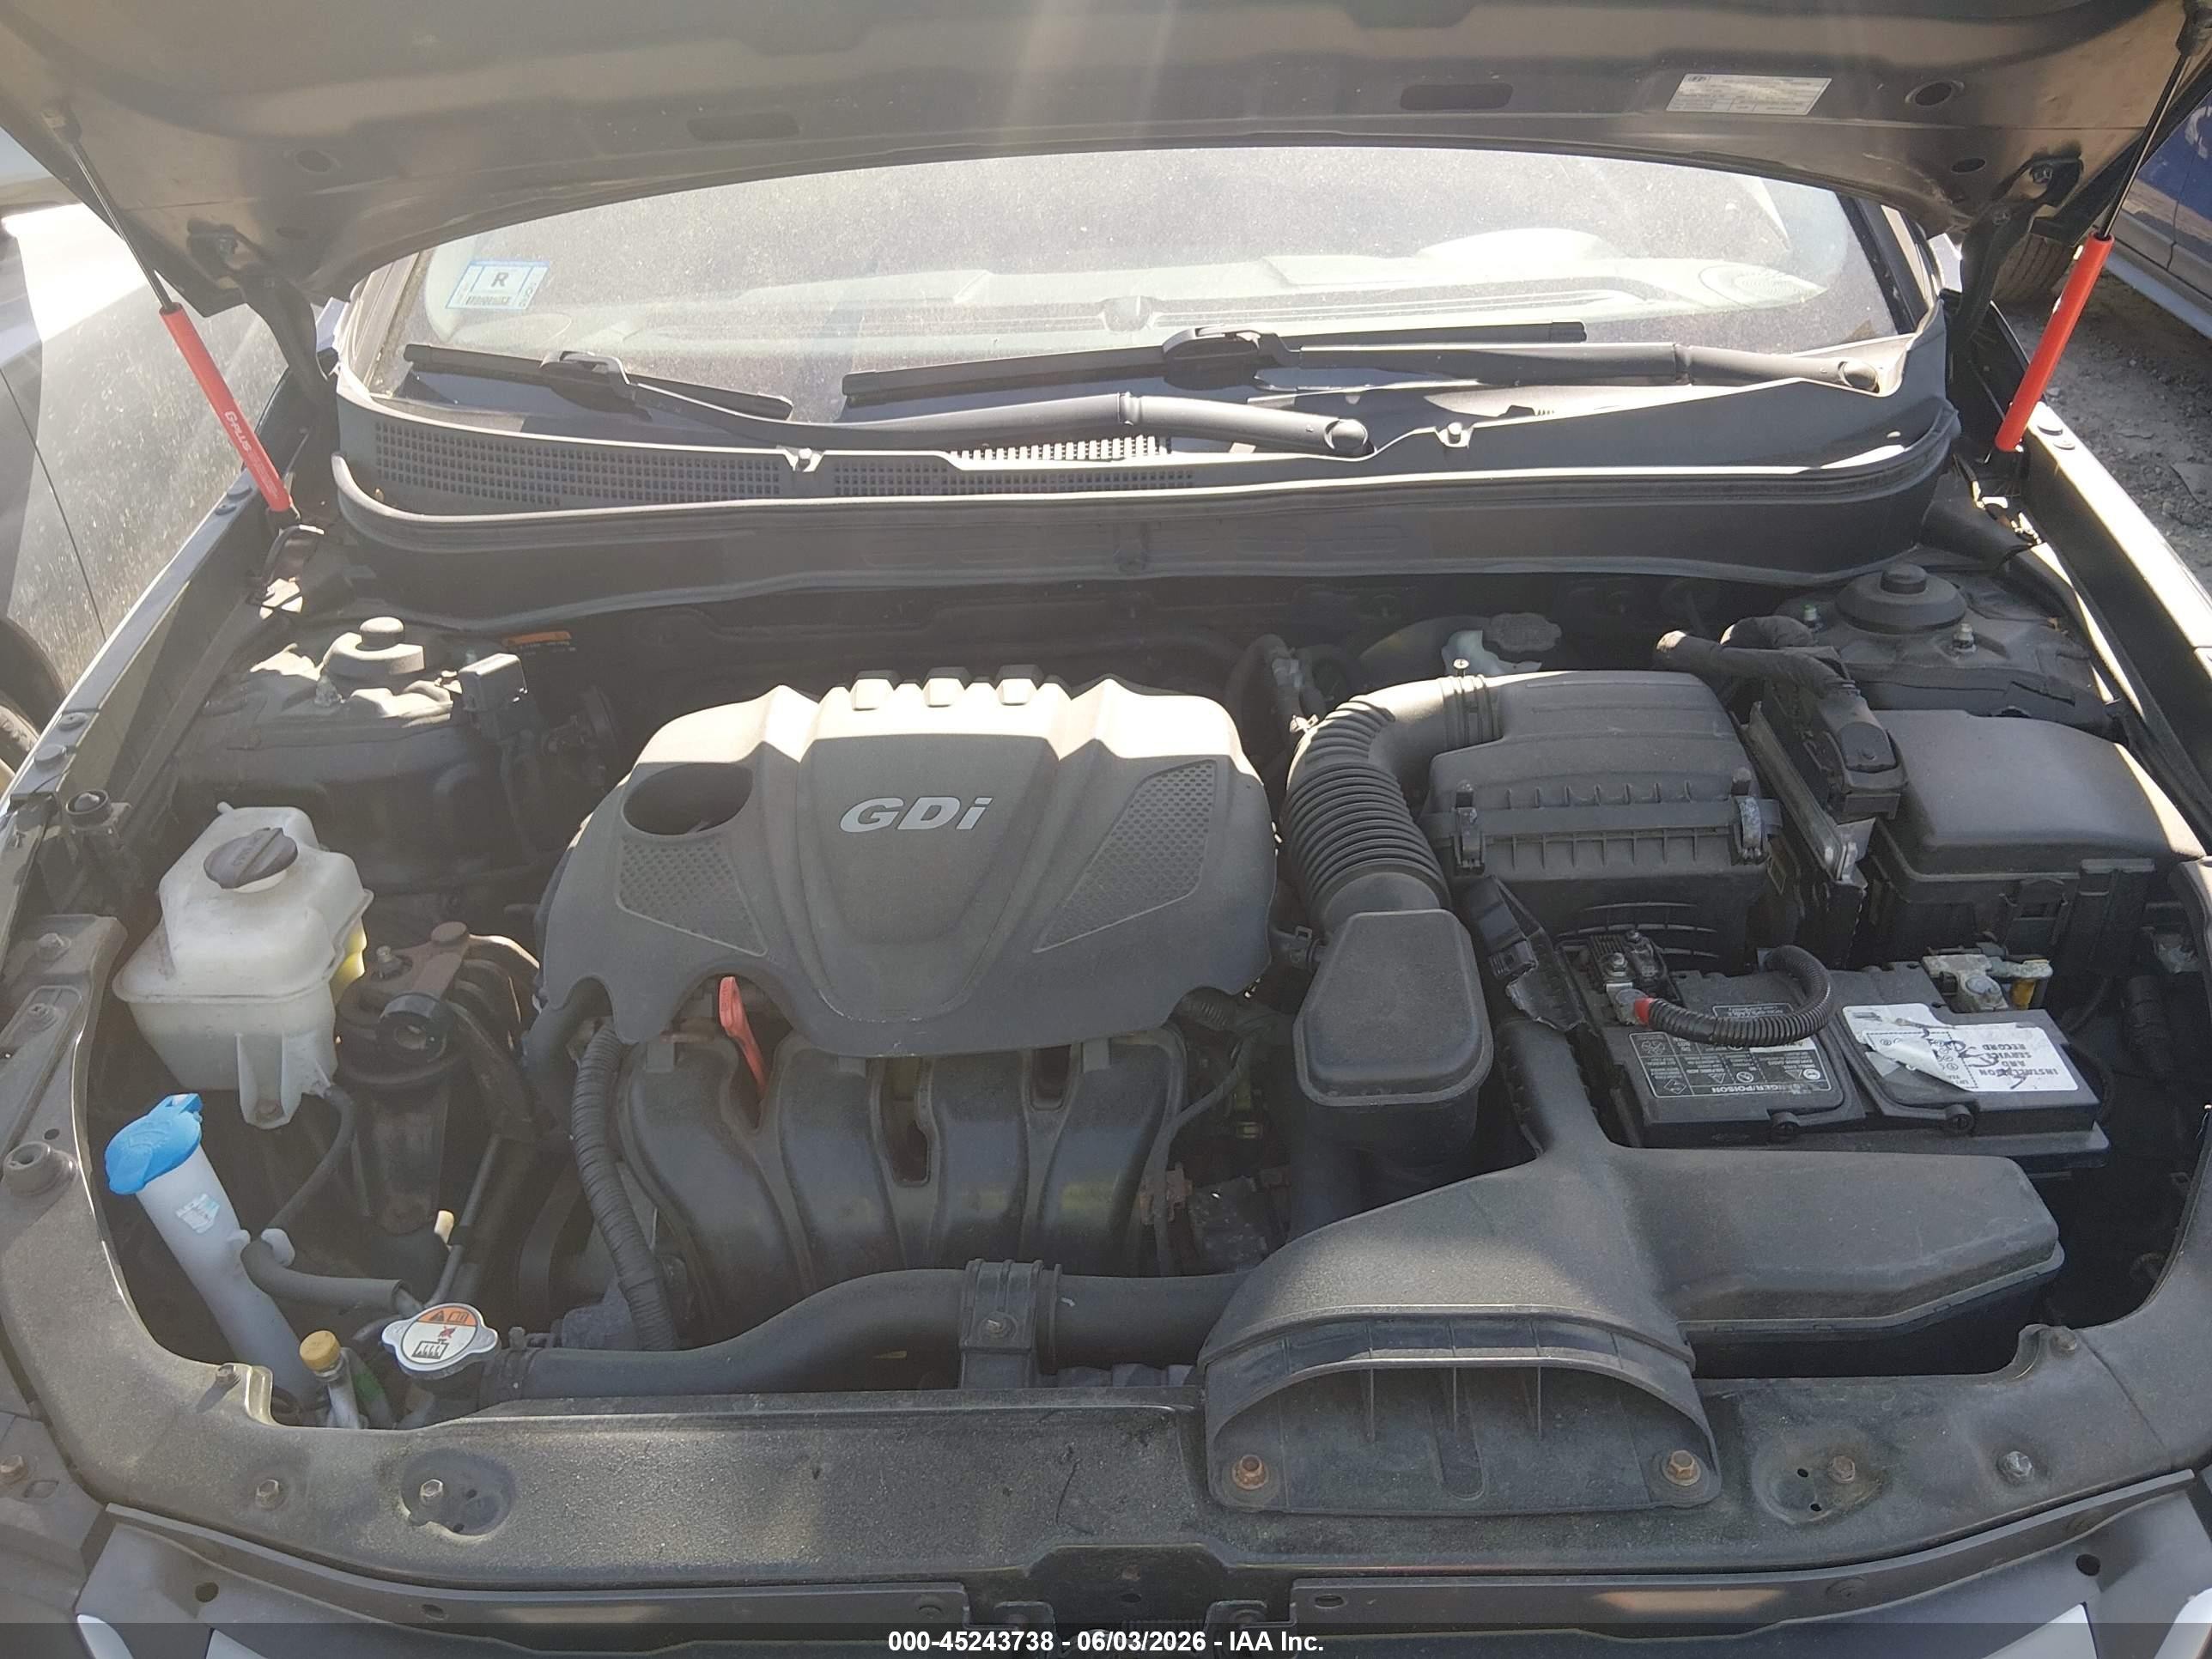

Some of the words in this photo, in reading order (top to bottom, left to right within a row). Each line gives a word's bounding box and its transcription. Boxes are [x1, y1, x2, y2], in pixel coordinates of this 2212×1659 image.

[491, 272, 509, 287] R
[839, 796, 994, 833] GDi
[1711, 1084, 1800, 1093] NGER/POISON
